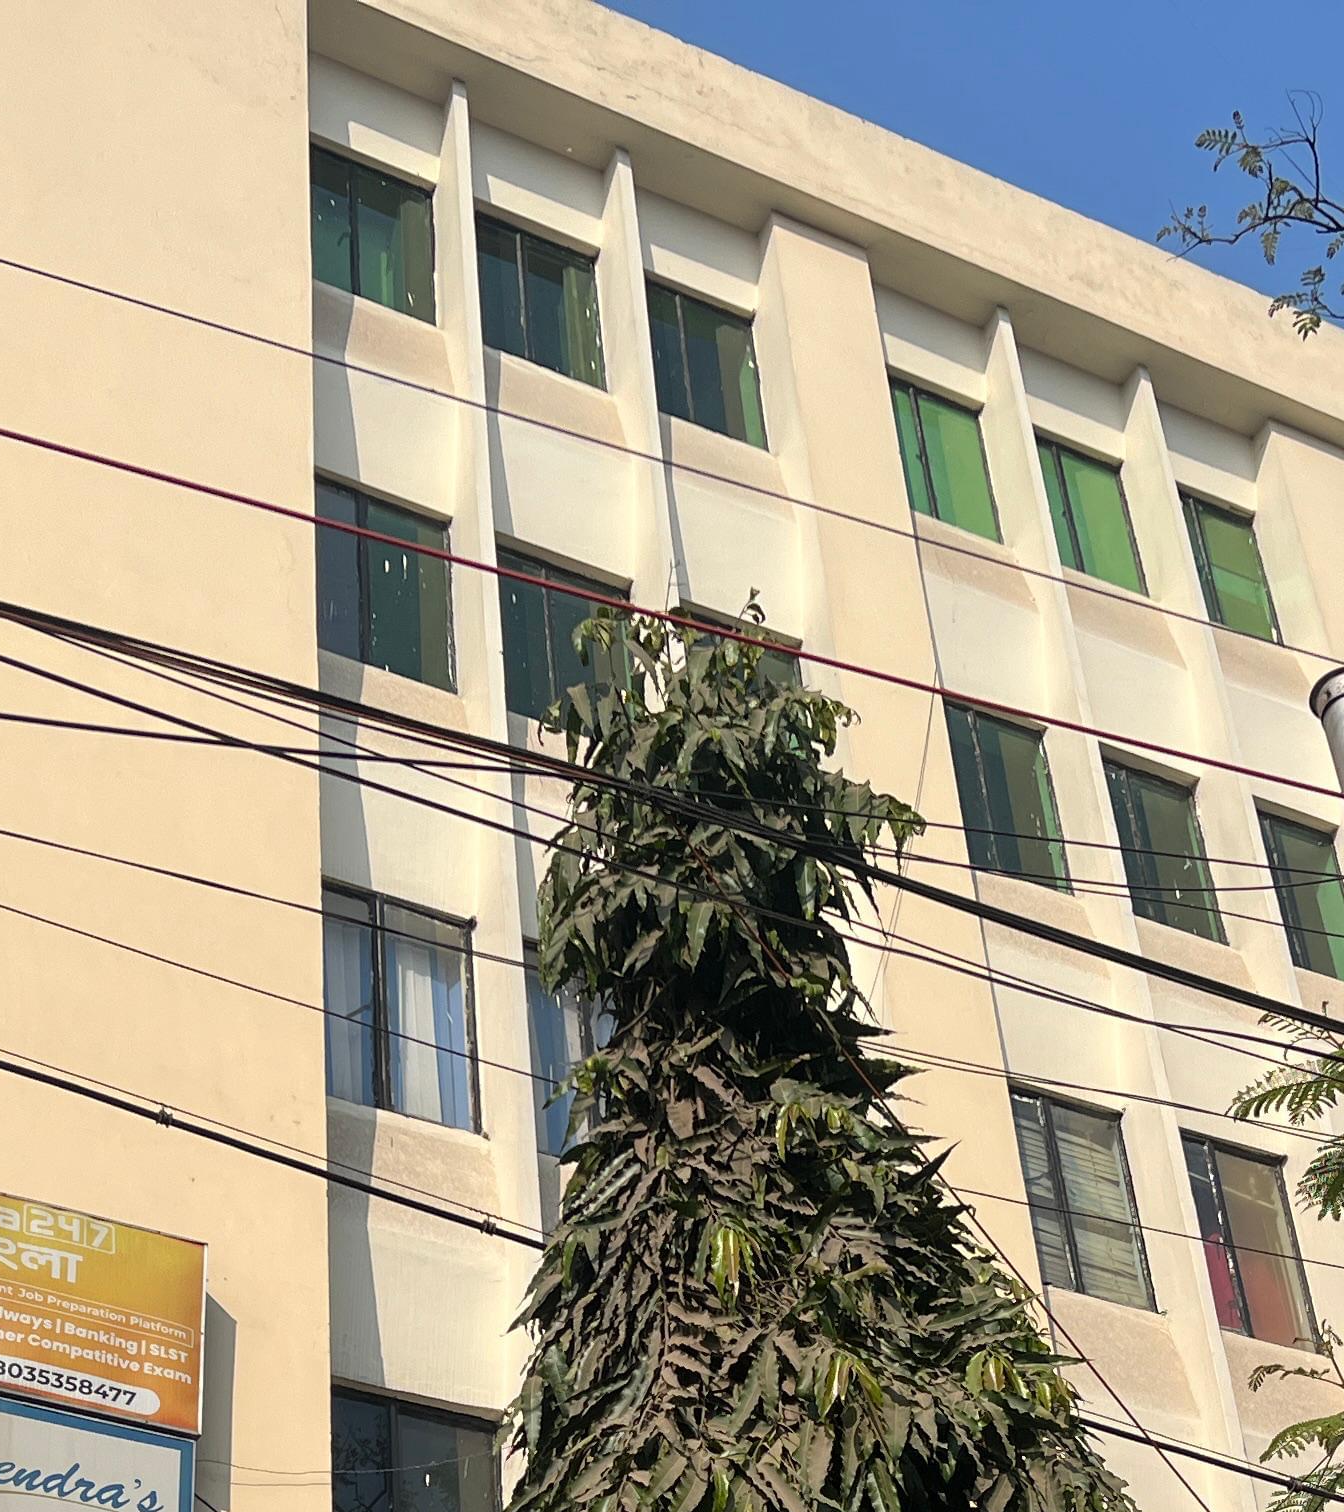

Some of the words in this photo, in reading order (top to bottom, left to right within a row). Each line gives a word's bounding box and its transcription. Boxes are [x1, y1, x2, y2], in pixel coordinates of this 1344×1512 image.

[18, 1287, 44, 1302] Job
[47, 1295, 126, 1323] Preparation
[129, 1316, 187, 1340] Platform
[27, 1332, 141, 1373] Compatitive
[143, 1361, 193, 1385] Exam
[64, 1322, 138, 1356] Banking
[149, 1343, 189, 1364] SLST
